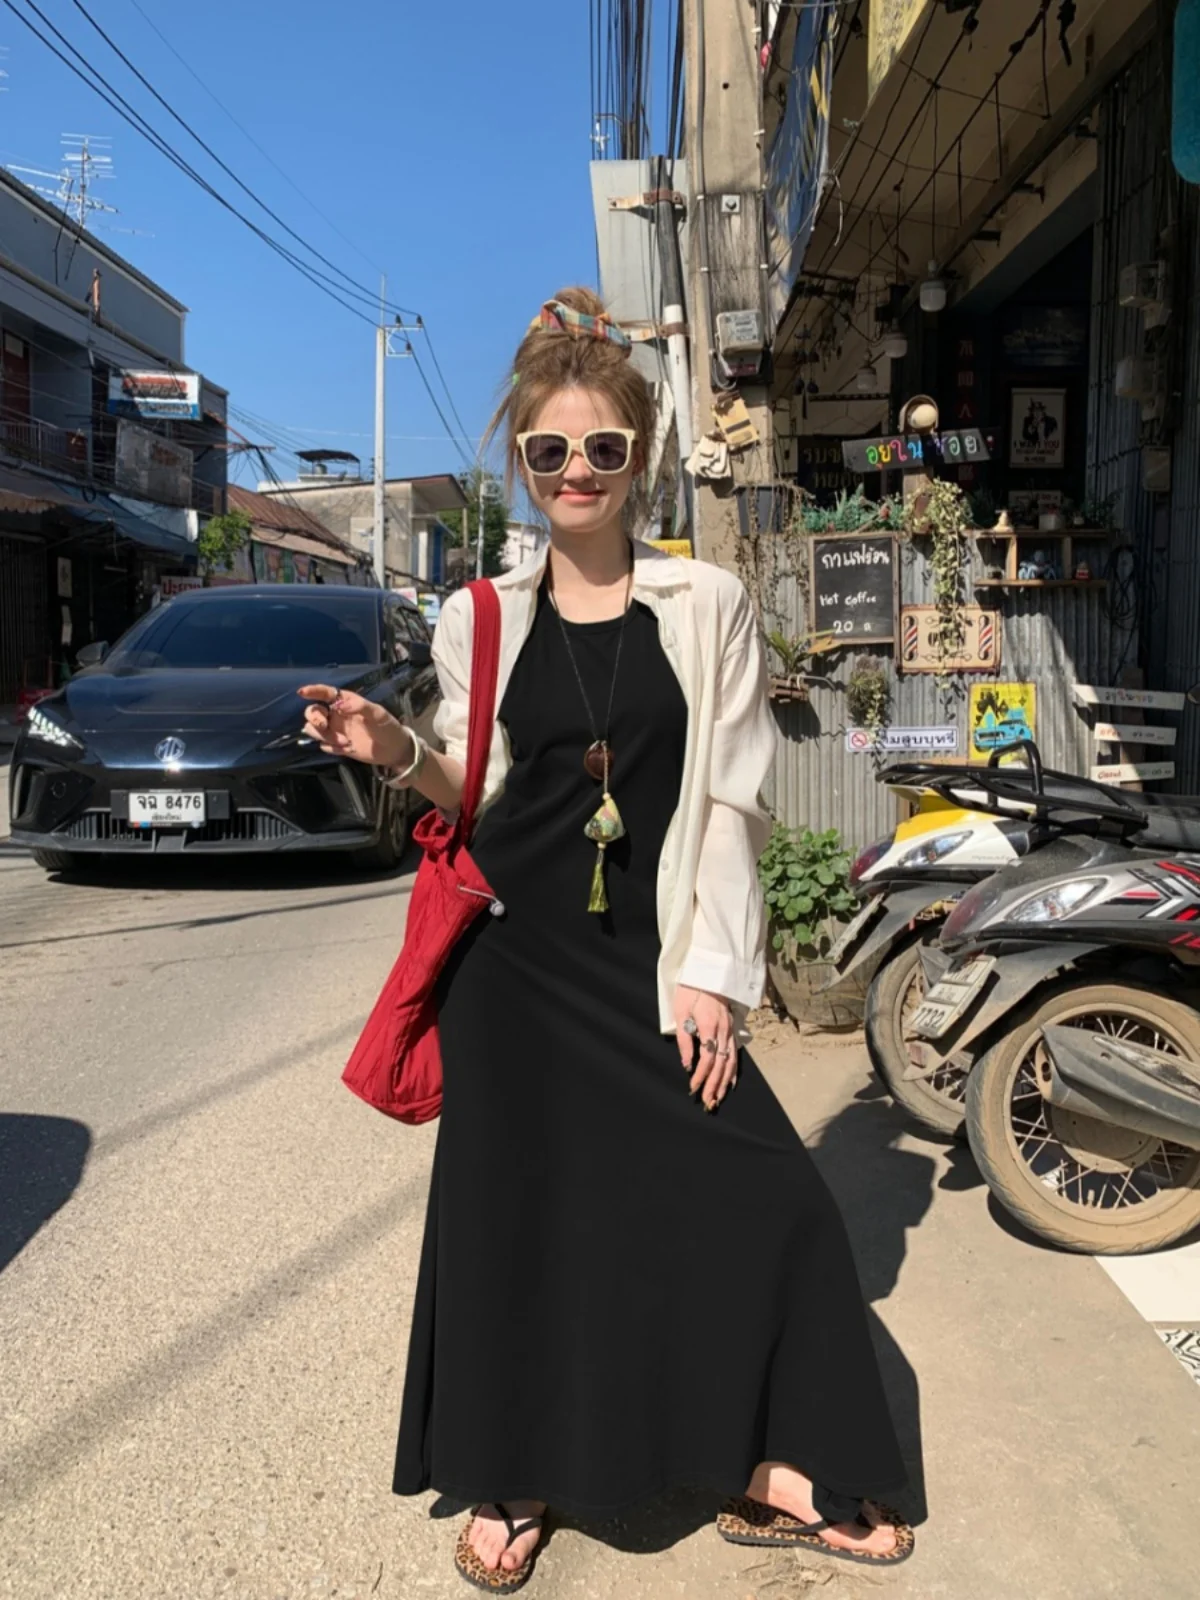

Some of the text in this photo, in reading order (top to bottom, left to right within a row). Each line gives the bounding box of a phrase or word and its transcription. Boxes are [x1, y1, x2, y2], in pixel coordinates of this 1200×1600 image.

[822, 543, 890, 569] กาแฟร้อน
[820, 592, 839, 607] Hot
[833, 620, 853, 634] 20
[157, 738, 182, 761] MG
[137, 795, 202, 810] จฉ 8476
